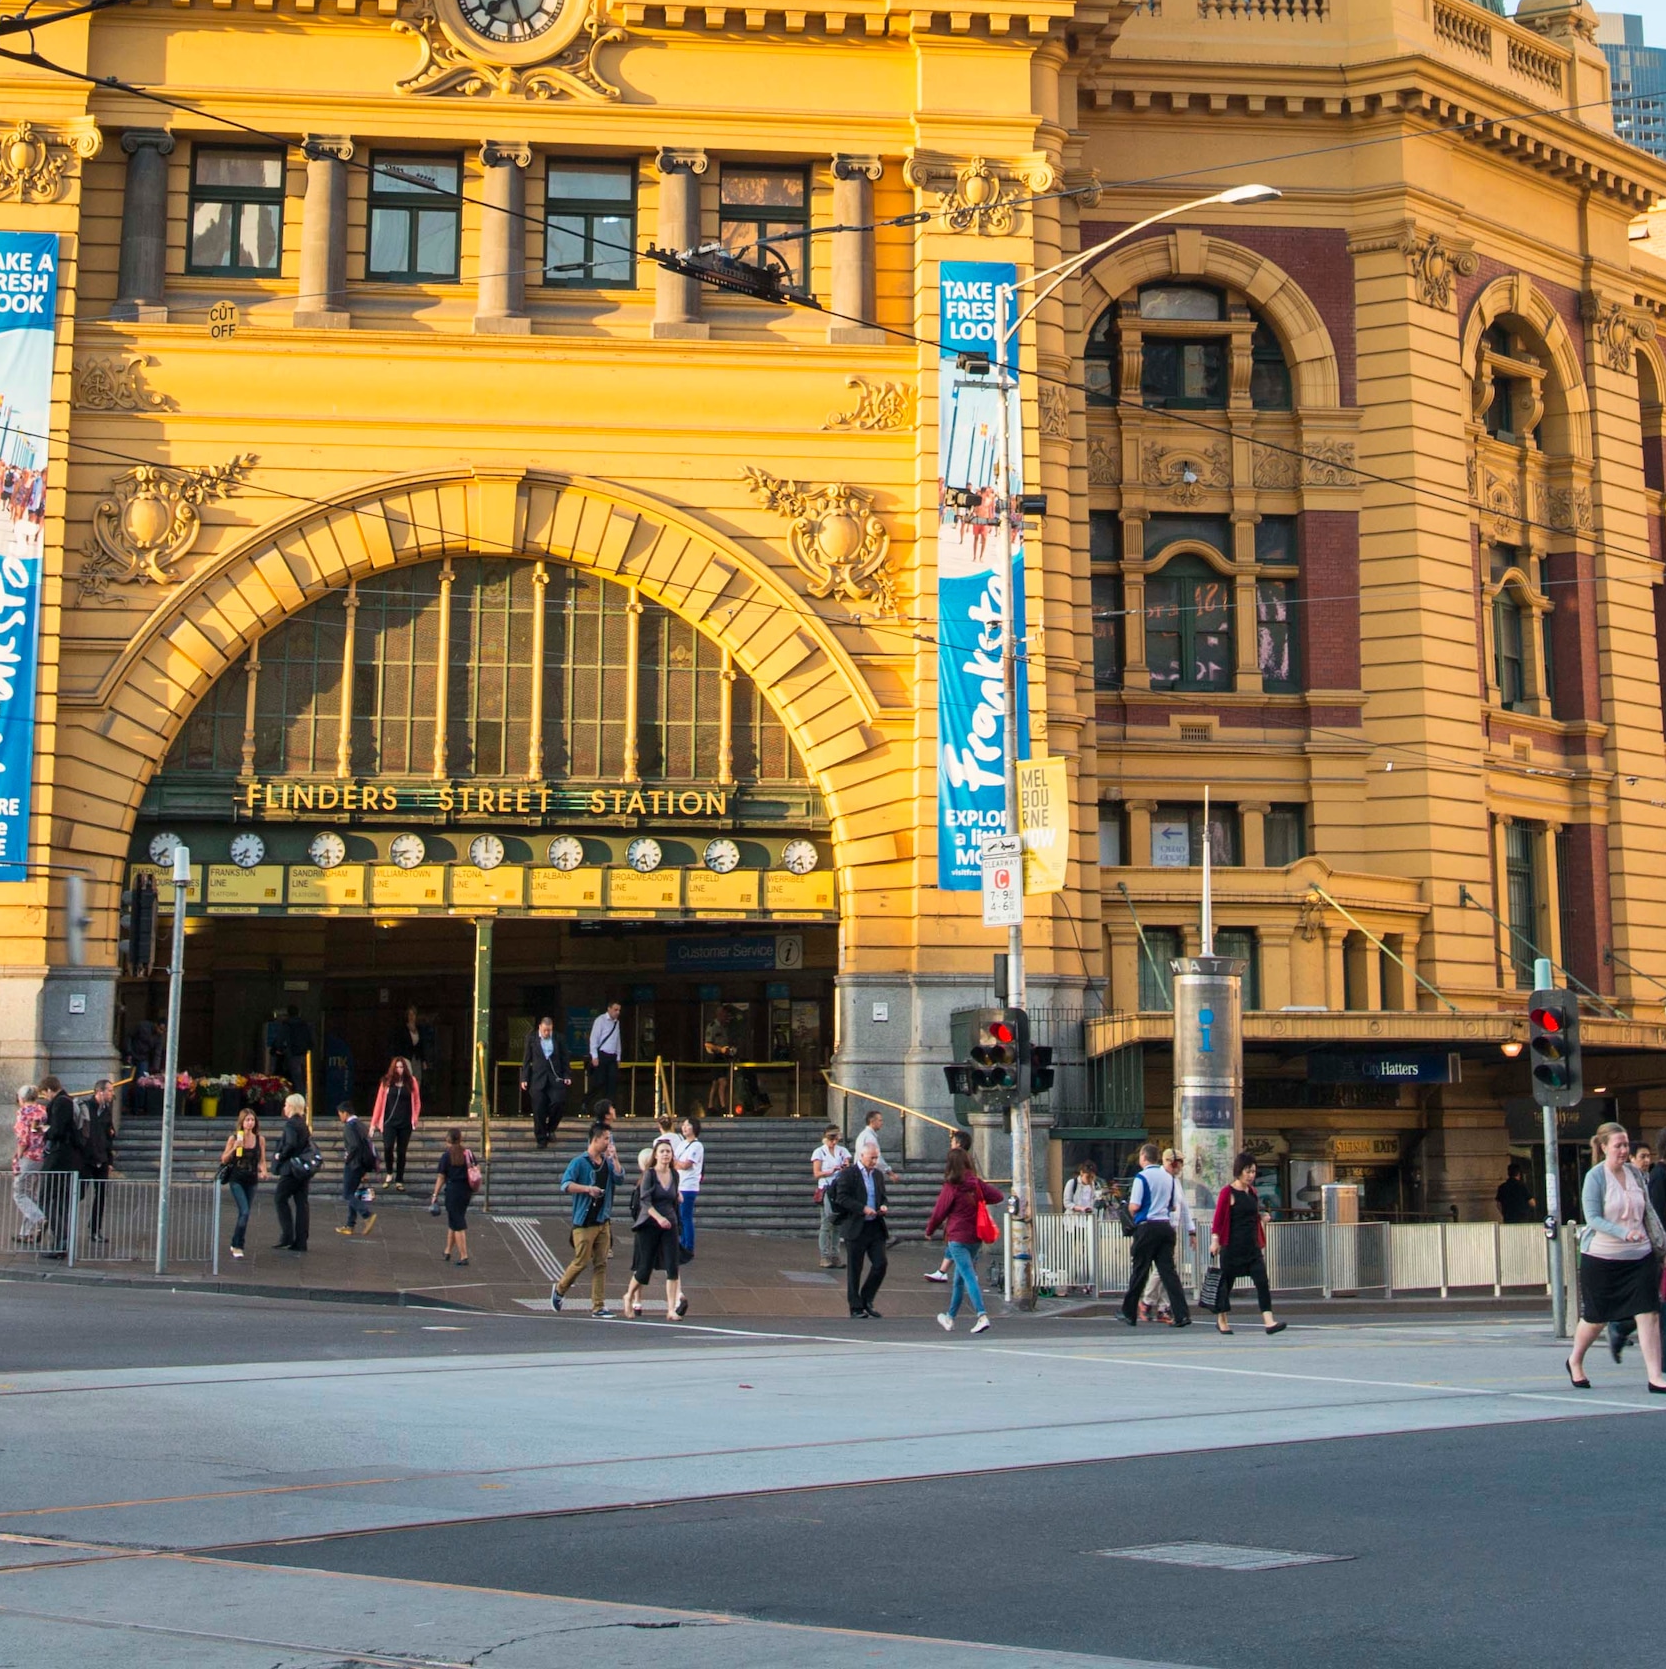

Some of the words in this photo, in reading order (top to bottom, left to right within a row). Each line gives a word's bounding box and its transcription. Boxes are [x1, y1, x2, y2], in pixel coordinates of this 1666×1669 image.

[37, 253, 54, 272] A
[942, 281, 993, 301] TAKE
[950, 321, 999, 341] LOO
[1021, 768, 1049, 789] MEL
[245, 783, 398, 811] FLINDERS
[438, 786, 553, 814] STREET
[589, 789, 727, 816] STATION
[1022, 789, 1049, 809] BOU
[945, 809, 1006, 827] EXPLO
[1023, 809, 1049, 829] RNE
[955, 832, 967, 847] a
[984, 859, 1019, 869] CLEARWAY
[210, 868, 256, 877] FRANKSTON
[292, 869, 348, 878] SANDRINGHAM
[373, 869, 431, 878] WILLIAMSTOWN
[453, 870, 482, 878] ALTONA
[543, 872, 572, 880] ALBANS
[610, 873, 674, 882] BROADMEADOWS
[689, 874, 720, 883] UPFIELD
[767, 875, 806, 883] WERRIBEE
[996, 870, 1008, 889] C
[210, 879, 226, 887] LINE
[292, 880, 309, 888] LINE
[373, 880, 389, 888] LINE
[452, 881, 469, 889] LINE
[531, 882, 548, 890] LINE
[609, 883, 627, 891] LINE
[689, 885, 706, 893] LINE
[766, 885, 783, 893] LINE
[678, 944, 731, 958] Customer
[733, 943, 774, 957] Service
[1373, 1139, 1397, 1154] HATS
